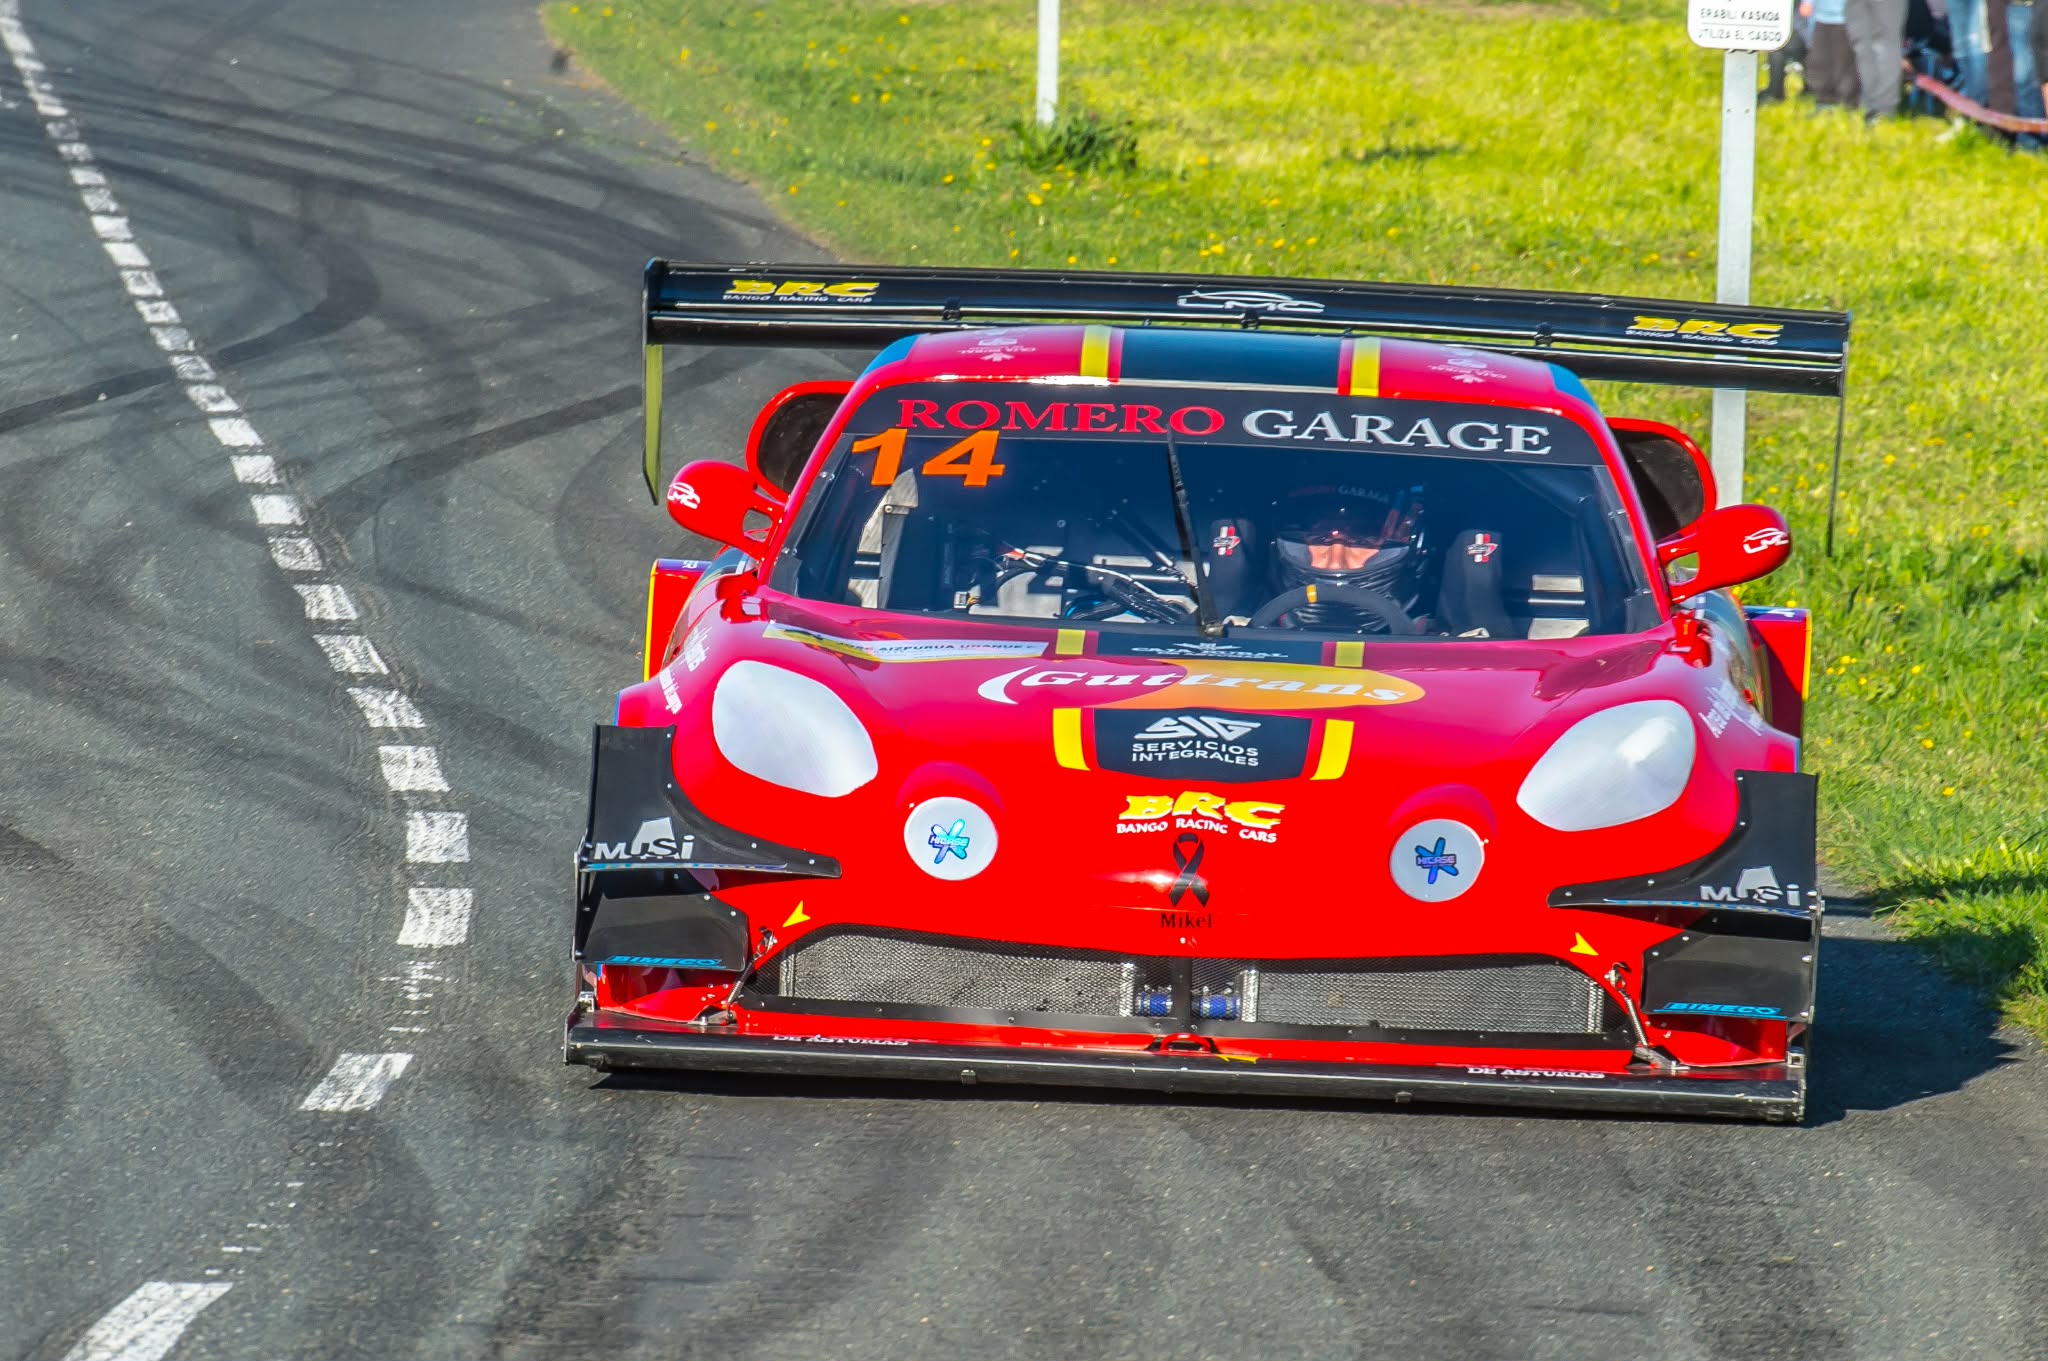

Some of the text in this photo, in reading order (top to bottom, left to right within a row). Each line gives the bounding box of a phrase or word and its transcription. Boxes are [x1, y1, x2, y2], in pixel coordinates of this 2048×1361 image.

[1741, 10, 1780, 22] KASKOA
[1698, 28, 1782, 42] UTILIZA EL CASCO
[725, 279, 880, 298] BRC
[1177, 294, 1325, 313] LMC
[1627, 315, 1784, 340] BRC
[1625, 329, 1779, 346] BANGO RACING CARS
[895, 398, 1552, 456] ROMERO GARAGE
[851, 428, 1006, 488] 14
[878, 643, 954, 652] AIZPURUA
[1202, 649, 1289, 659] RURAL
[1020, 670, 1406, 703] Guttrans
[1134, 715, 1262, 742] SIG
[1132, 740, 1259, 757] SERVICIOS
[1131, 749, 1259, 767] INTEGRALES
[1118, 790, 1286, 830] BRC
[1116, 818, 1278, 844] BANGO RACING CARS
[1160, 913, 1213, 929] Mikel
[1668, 1002, 1777, 1015] BIMECO
[805, 1035, 910, 1046] ASTURIAS
[1467, 1066, 1606, 1079] DE ASTURIAS
